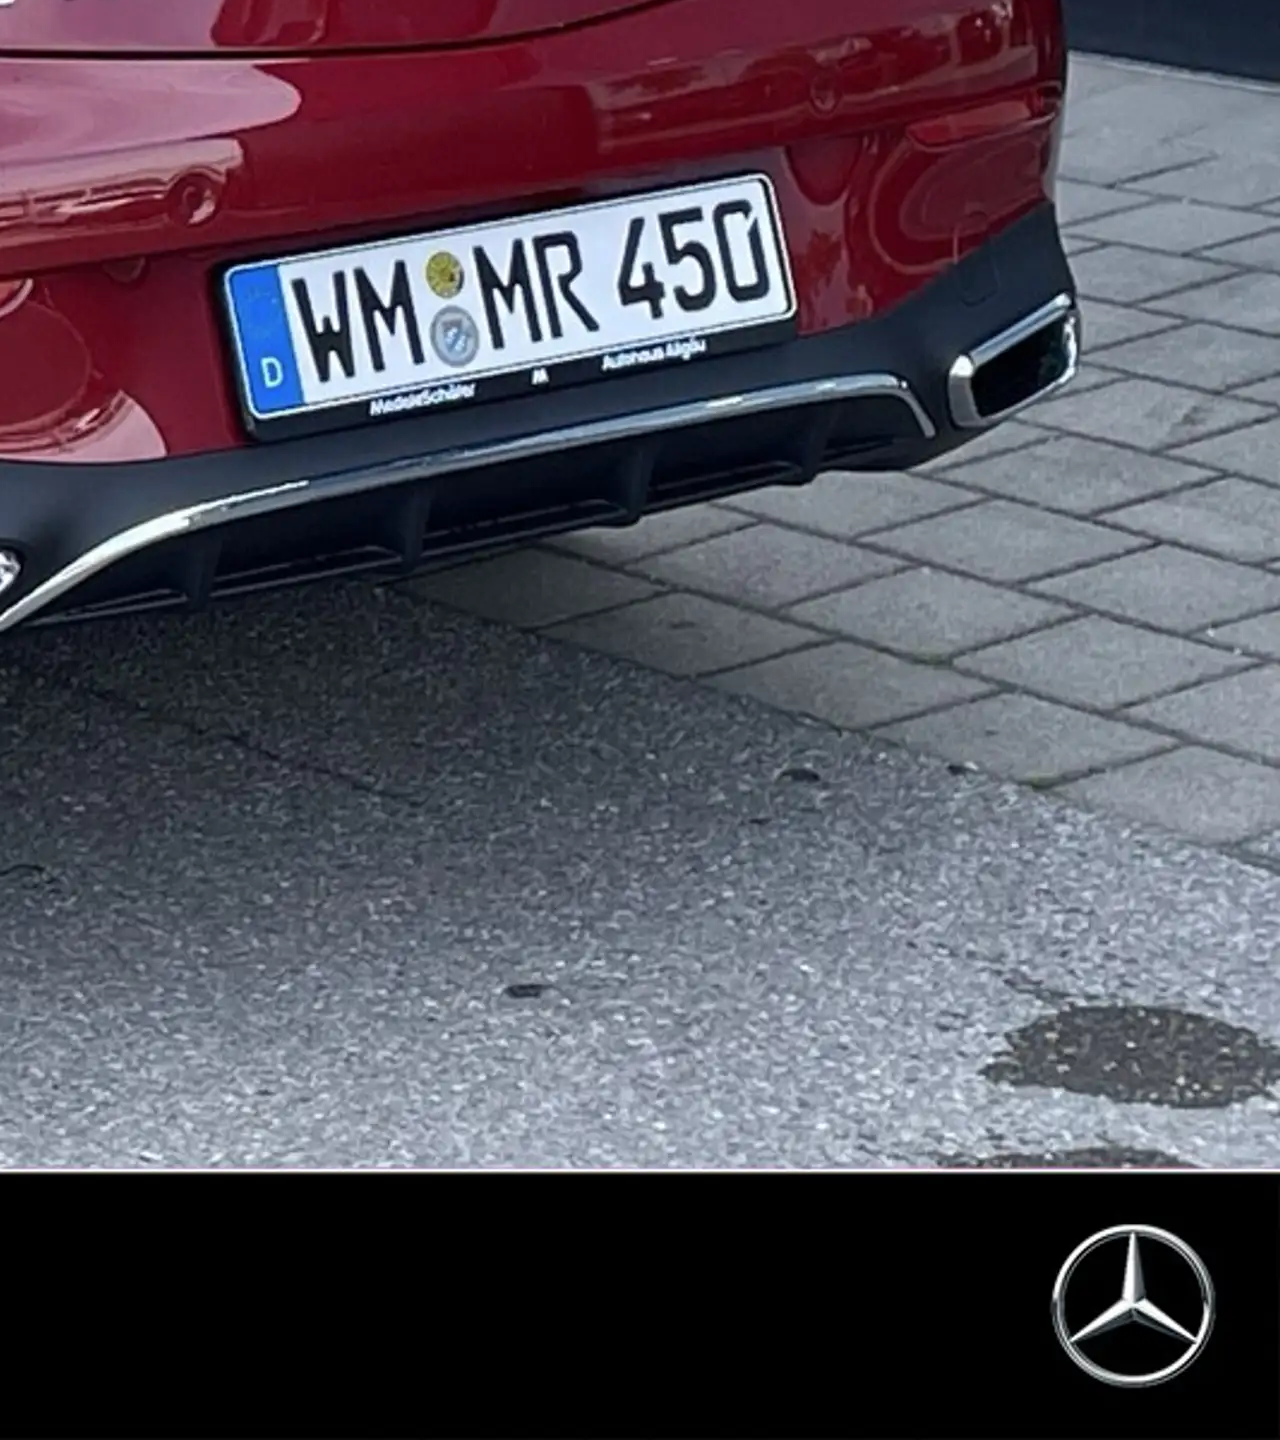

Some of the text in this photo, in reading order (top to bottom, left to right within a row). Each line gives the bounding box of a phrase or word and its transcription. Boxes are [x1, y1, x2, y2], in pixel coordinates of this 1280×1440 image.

[290, 198, 771, 384] WM MR 450
[261, 356, 284, 389] D
